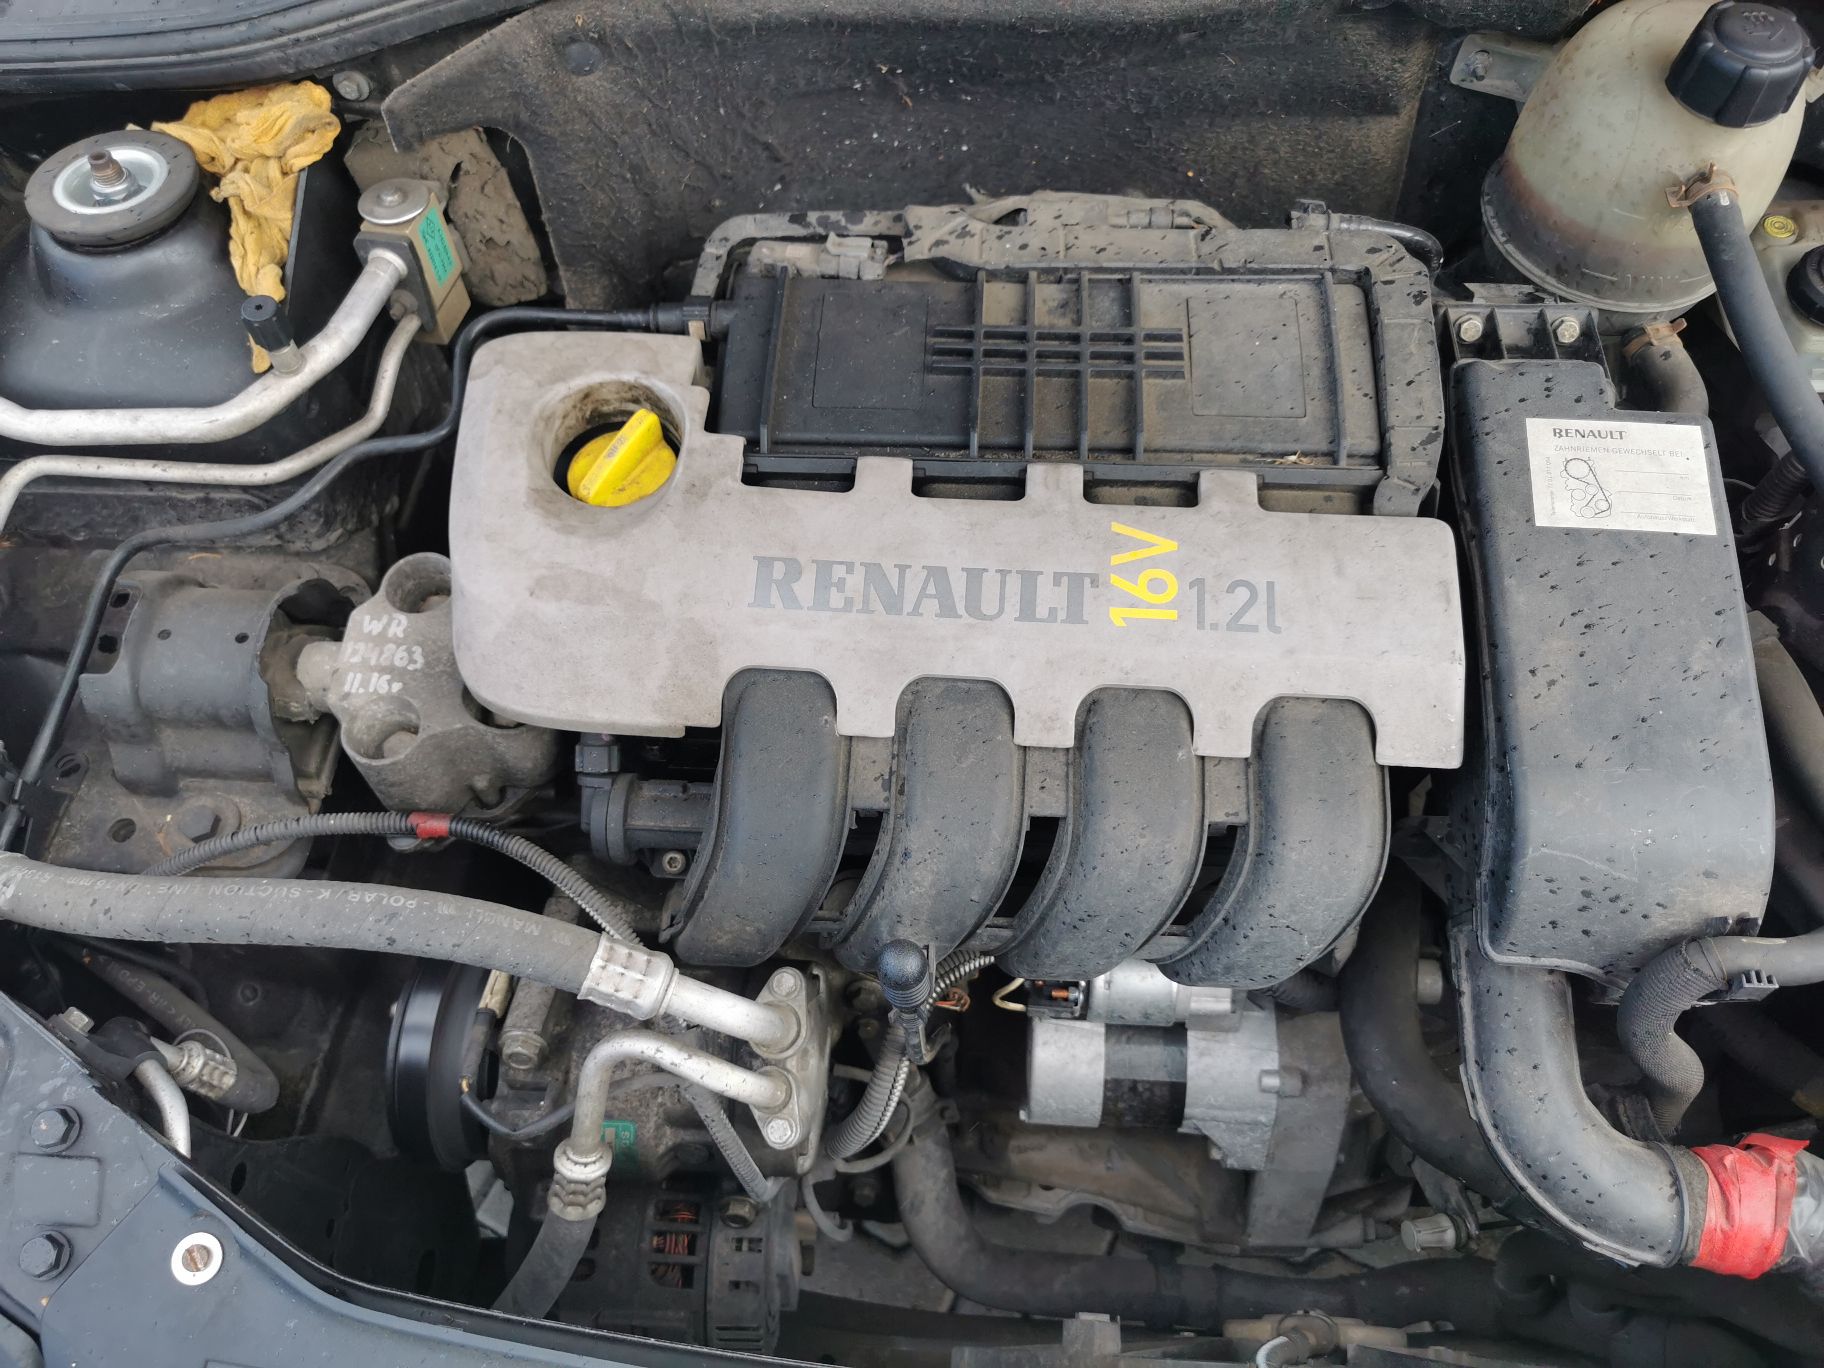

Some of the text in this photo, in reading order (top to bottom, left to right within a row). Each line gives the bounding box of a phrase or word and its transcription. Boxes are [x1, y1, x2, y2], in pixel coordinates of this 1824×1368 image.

[1552, 427, 1627, 440] RENAULT
[747, 555, 1099, 624] RENAULT
[1110, 521, 1179, 628] 16V
